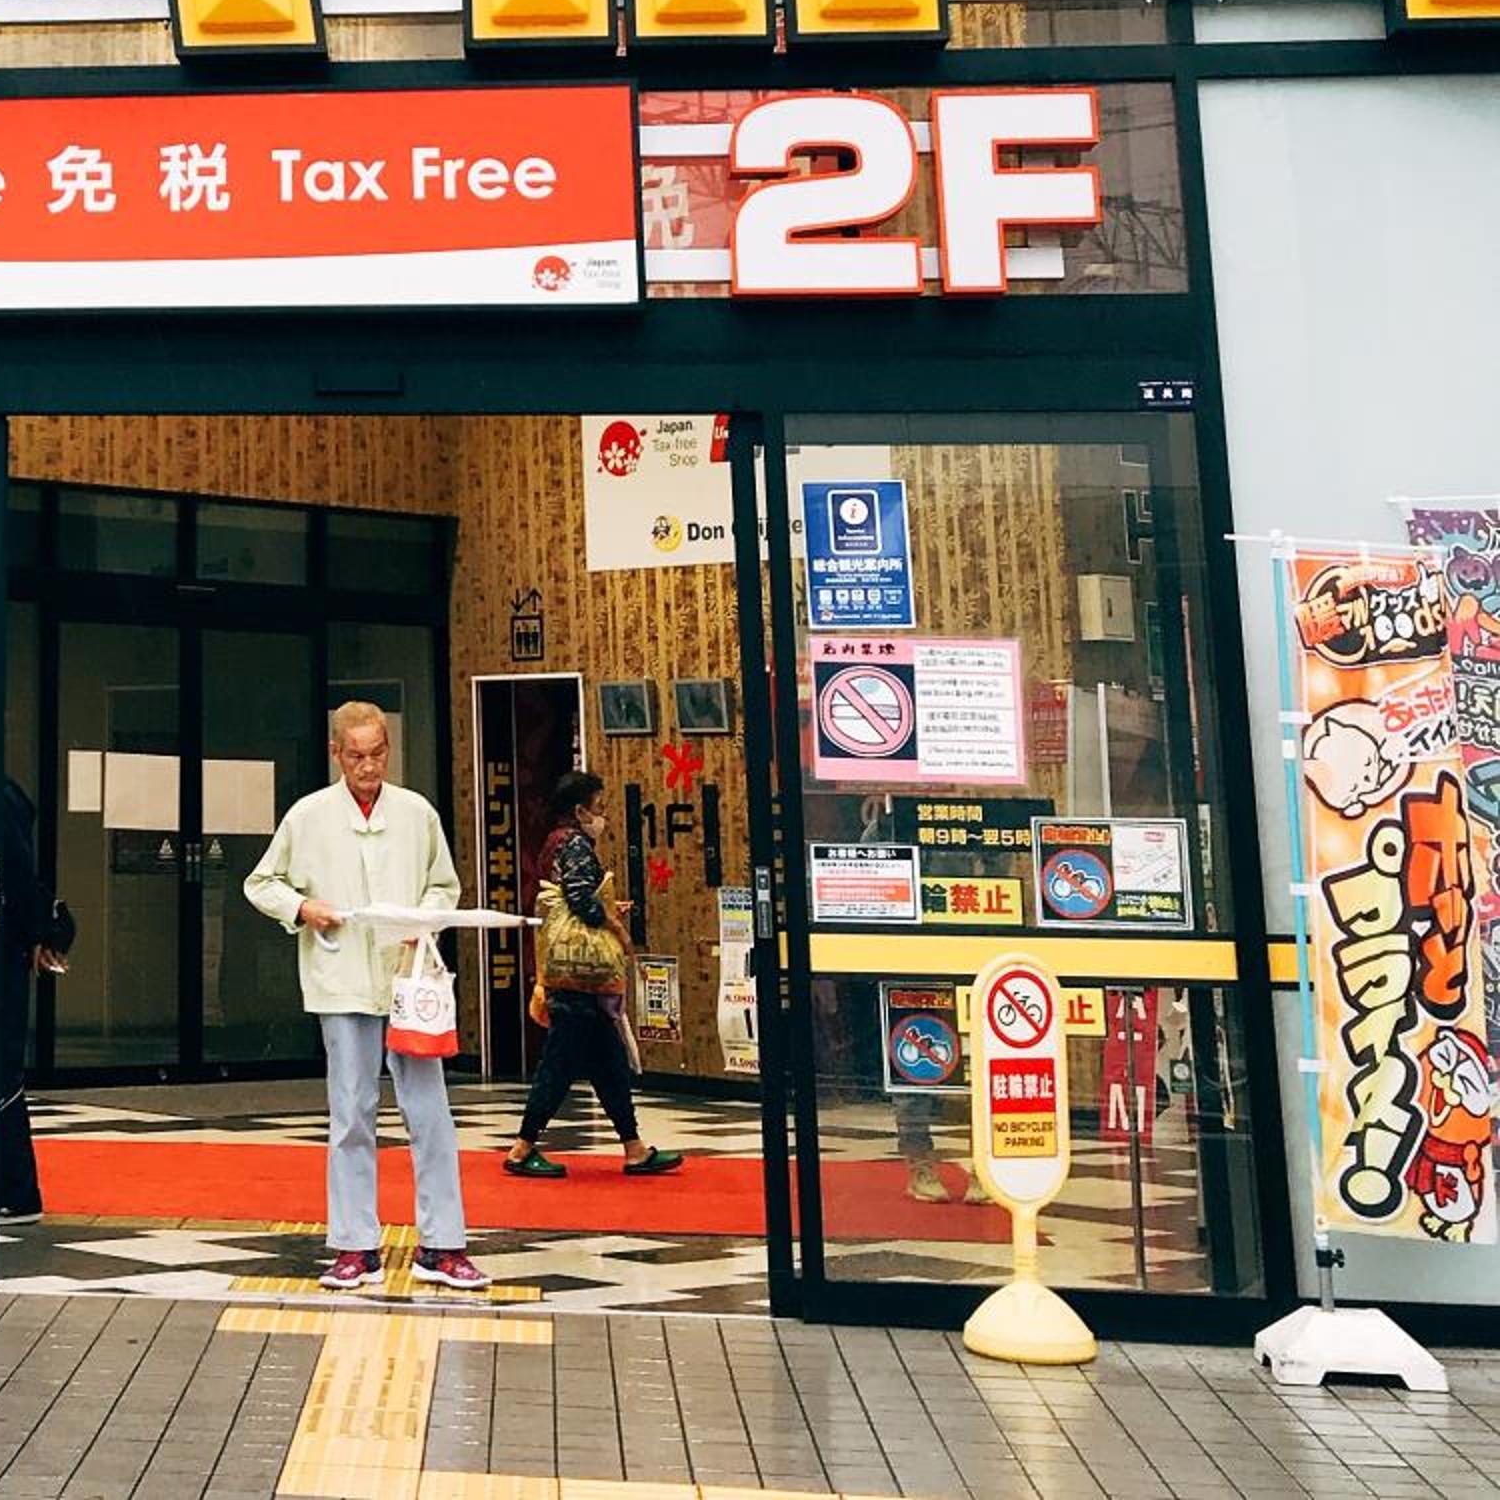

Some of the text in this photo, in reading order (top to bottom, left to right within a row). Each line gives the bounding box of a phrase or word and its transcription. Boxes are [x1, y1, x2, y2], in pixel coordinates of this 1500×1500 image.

[271, 148, 389, 202] Tax
[411, 146, 557, 201] Free
[730, 90, 1102, 296] 2F
[656, 419, 694, 435] Japan
[668, 452, 698, 467] Shop
[687, 522, 725, 541] Don
[916, 804, 983, 823] 営業時間
[643, 802, 695, 849] 1F
[1321, 818, 1421, 1218] プライス!
[991, 1073, 1054, 1100] 駐輪禁止
[1004, 1136, 1045, 1147] PARKING
